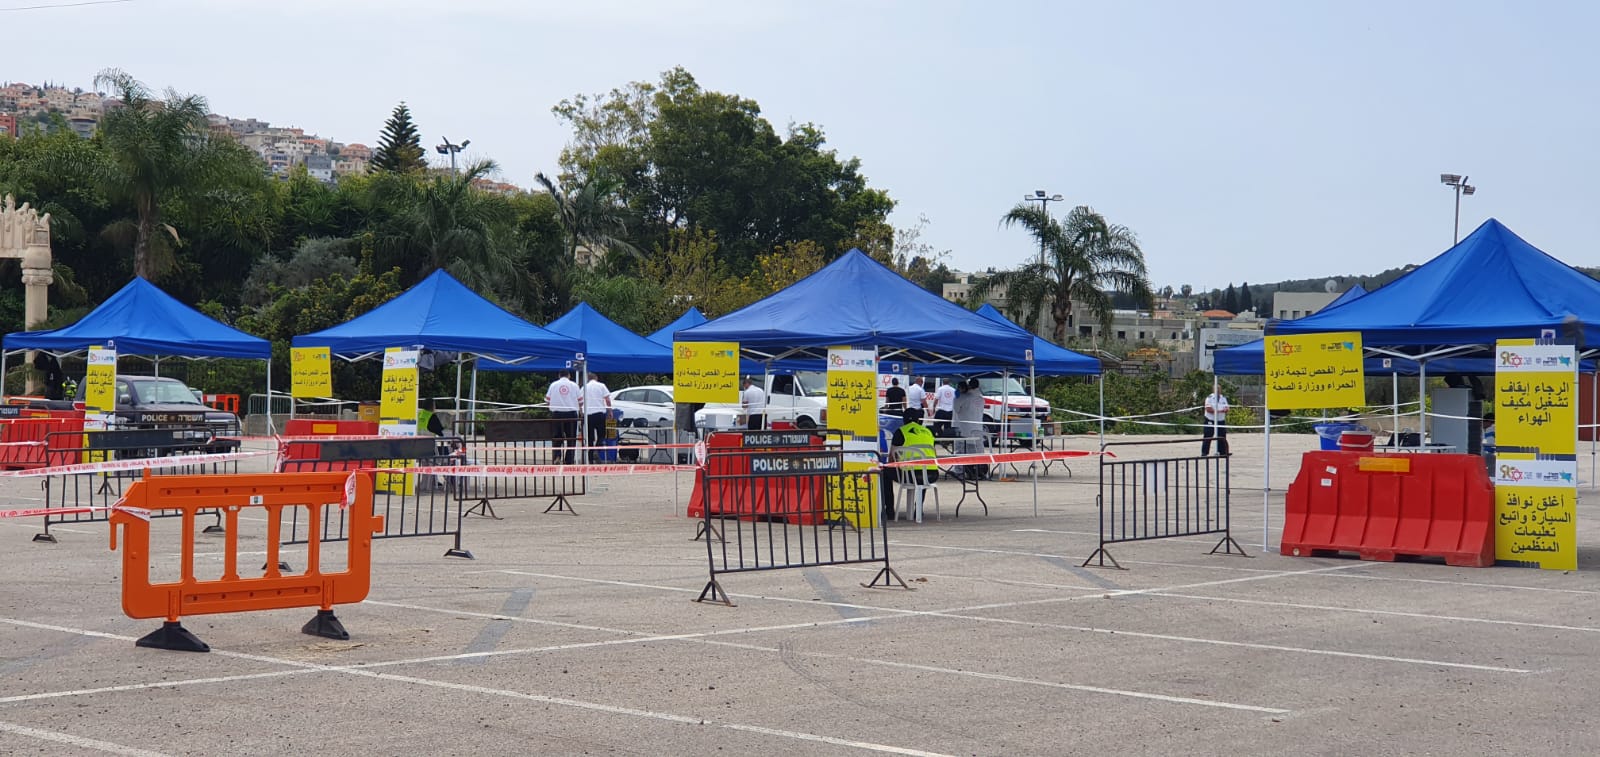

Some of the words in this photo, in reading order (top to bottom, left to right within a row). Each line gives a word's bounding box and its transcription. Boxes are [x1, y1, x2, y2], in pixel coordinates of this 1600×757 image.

[1270, 369, 1284, 378] داود
[1286, 366, 1307, 377] لنجمة
[1309, 366, 1336, 377] الفحص
[1339, 366, 1359, 376] مسار
[850, 378, 873, 391] الرجاء
[1272, 381, 1296, 391] الصحة
[1298, 382, 1325, 392] ووزارة
[1327, 379, 1356, 391] الحمراء
[1534, 381, 1570, 396] الرجاء
[831, 390, 849, 402] مكيف
[840, 402, 862, 414] الهواء
[1501, 396, 1532, 410] مكيف
[1535, 396, 1569, 410] تشغيل
[141, 414, 169, 422] POLICE
[1518, 412, 1552, 426] الهواء
[744, 434, 773, 445] POLICE
[782, 434, 809, 444] משטרה
[753, 458, 790, 471] POLICE
[803, 456, 838, 470] משטרה
[1506, 493, 1533, 509] نوافذ
[1536, 494, 1564, 511] أغلق
[1499, 511, 1527, 525] واتبع
[1532, 510, 1571, 525] السيارة
[1514, 525, 1556, 539] تعليمات
[1510, 538, 1560, 554] المنظمين
